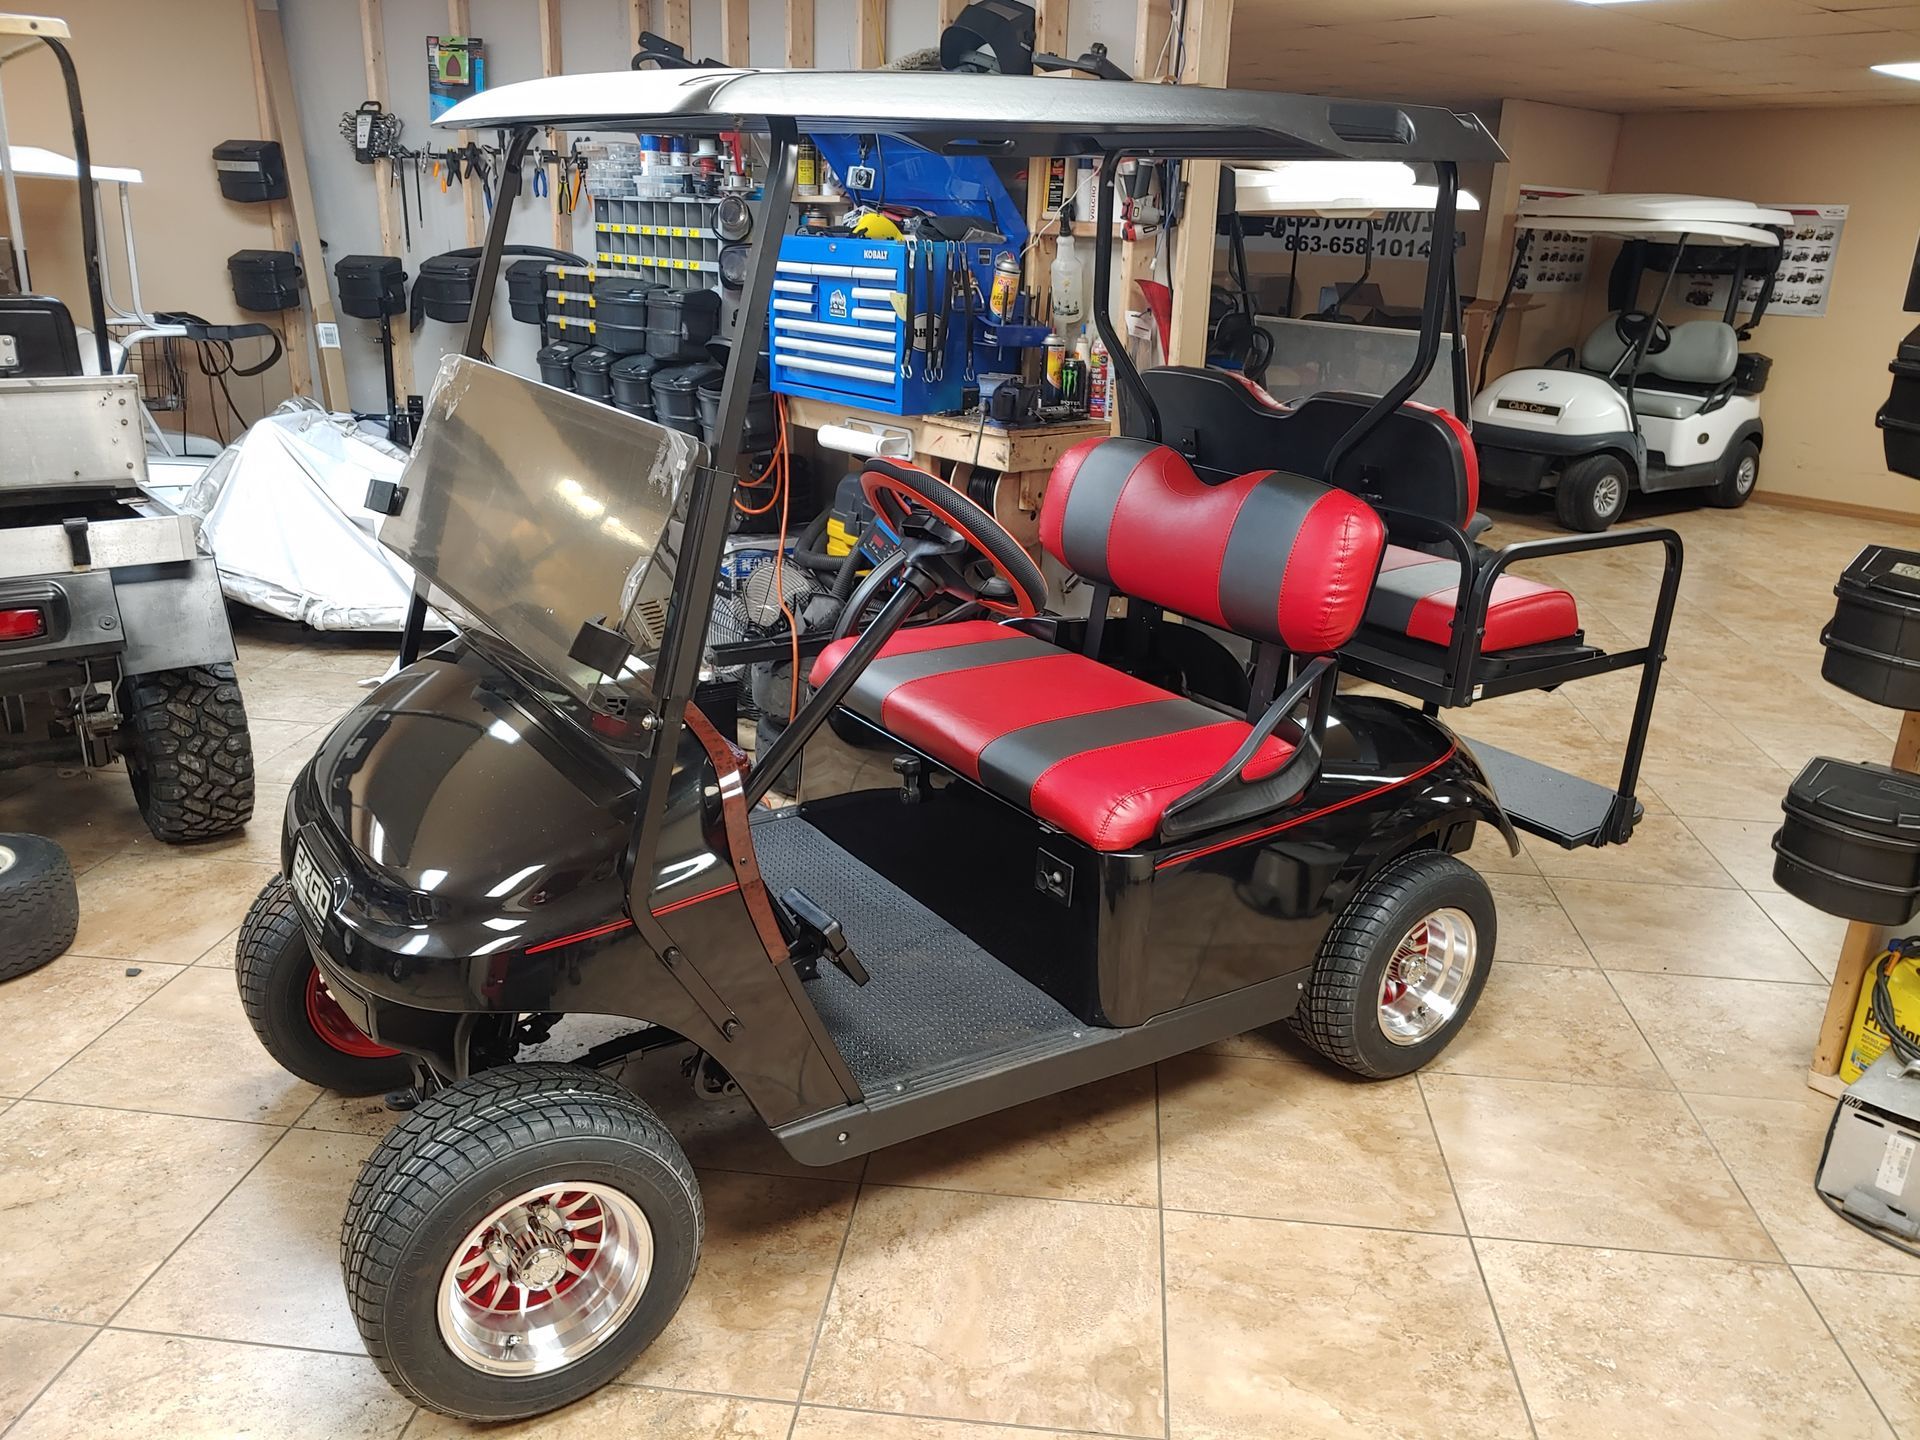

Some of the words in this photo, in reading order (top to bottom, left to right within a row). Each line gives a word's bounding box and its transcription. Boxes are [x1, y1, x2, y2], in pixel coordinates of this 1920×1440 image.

[863, 249, 888, 260] KOBALT
[1508, 401, 1528, 411] Club
[1529, 403, 1547, 413] Car
